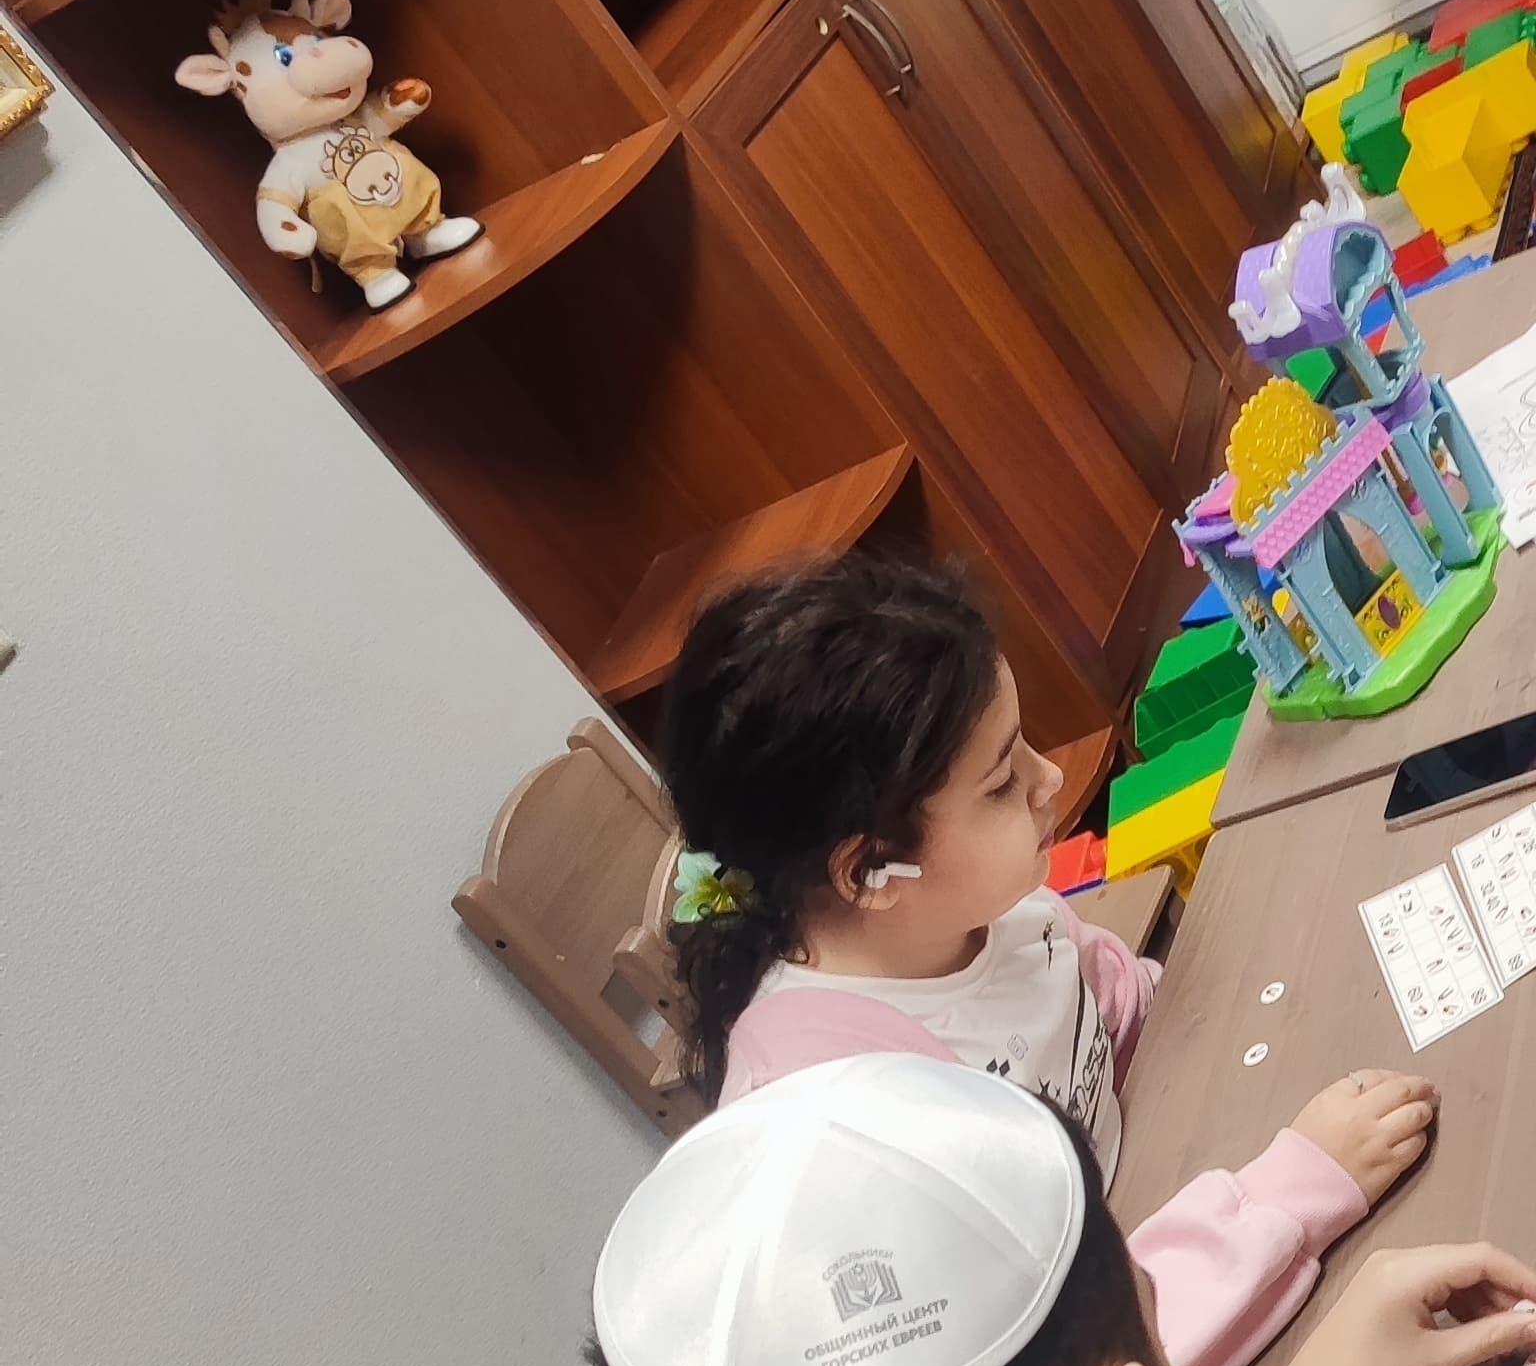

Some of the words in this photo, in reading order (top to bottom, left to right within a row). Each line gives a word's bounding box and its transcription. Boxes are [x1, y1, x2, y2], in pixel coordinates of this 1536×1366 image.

[822, 1247, 894, 1282] СОКОЛЬНИКИ
[804, 1312, 900, 1361] ОБЩИННЫЙ
[902, 1298, 950, 1326] ЦЕНТР
[892, 1319, 943, 1349] ЕВРЕЕВ
